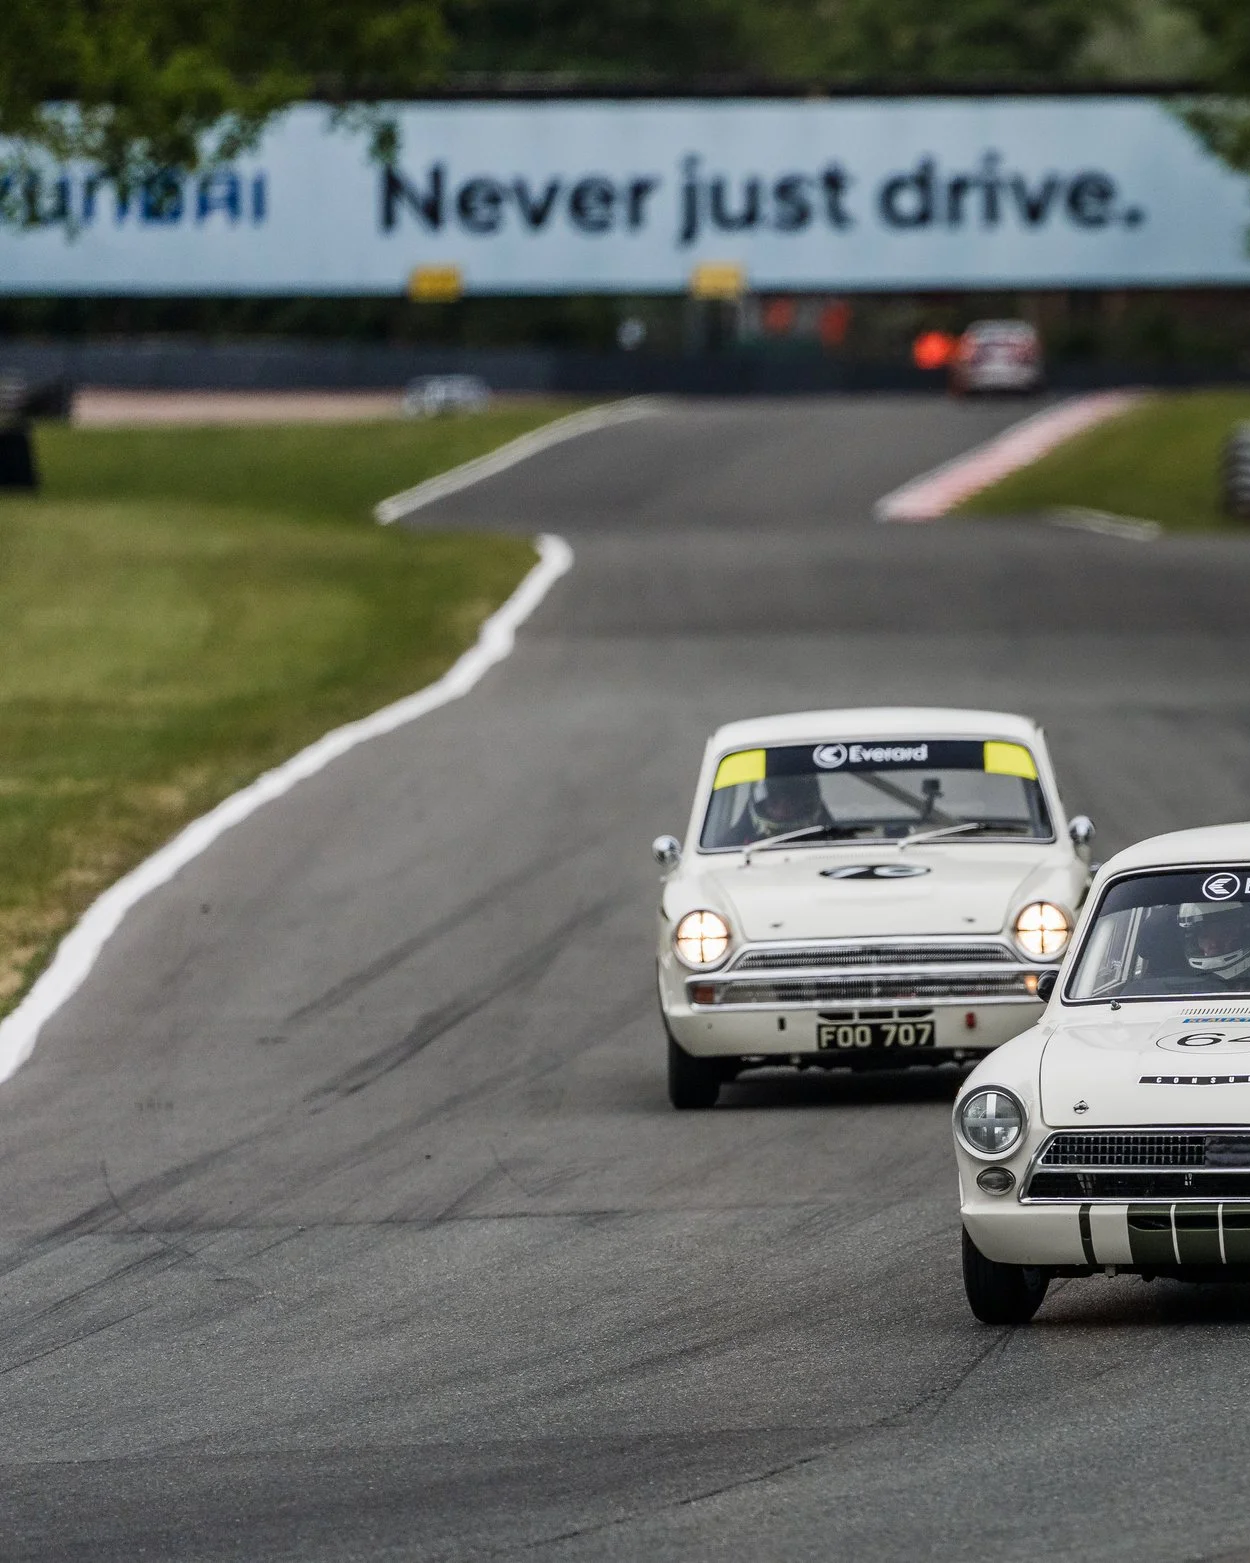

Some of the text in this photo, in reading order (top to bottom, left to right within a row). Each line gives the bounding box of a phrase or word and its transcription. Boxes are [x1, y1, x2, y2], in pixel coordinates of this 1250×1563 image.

[378, 149, 1146, 246] Never just drive.
[849, 743, 928, 763] Everard
[881, 1023, 932, 1047] 707
